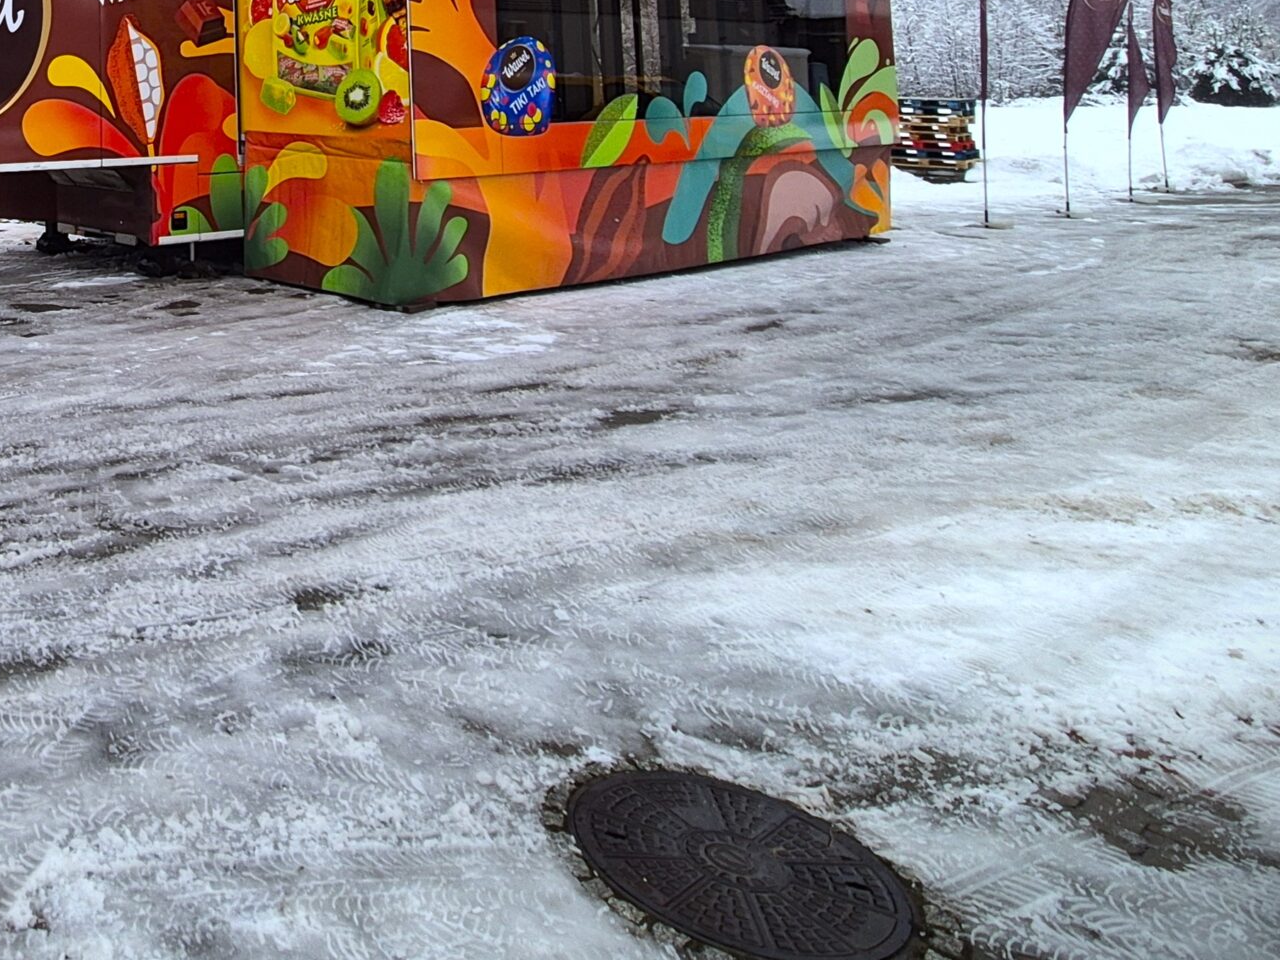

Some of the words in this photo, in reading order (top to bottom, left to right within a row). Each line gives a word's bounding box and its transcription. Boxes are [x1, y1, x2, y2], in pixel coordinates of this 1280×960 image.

[502, 50, 531, 79] Wawel
[509, 93, 528, 115] TIKI
[526, 77, 546, 98] TAKI
